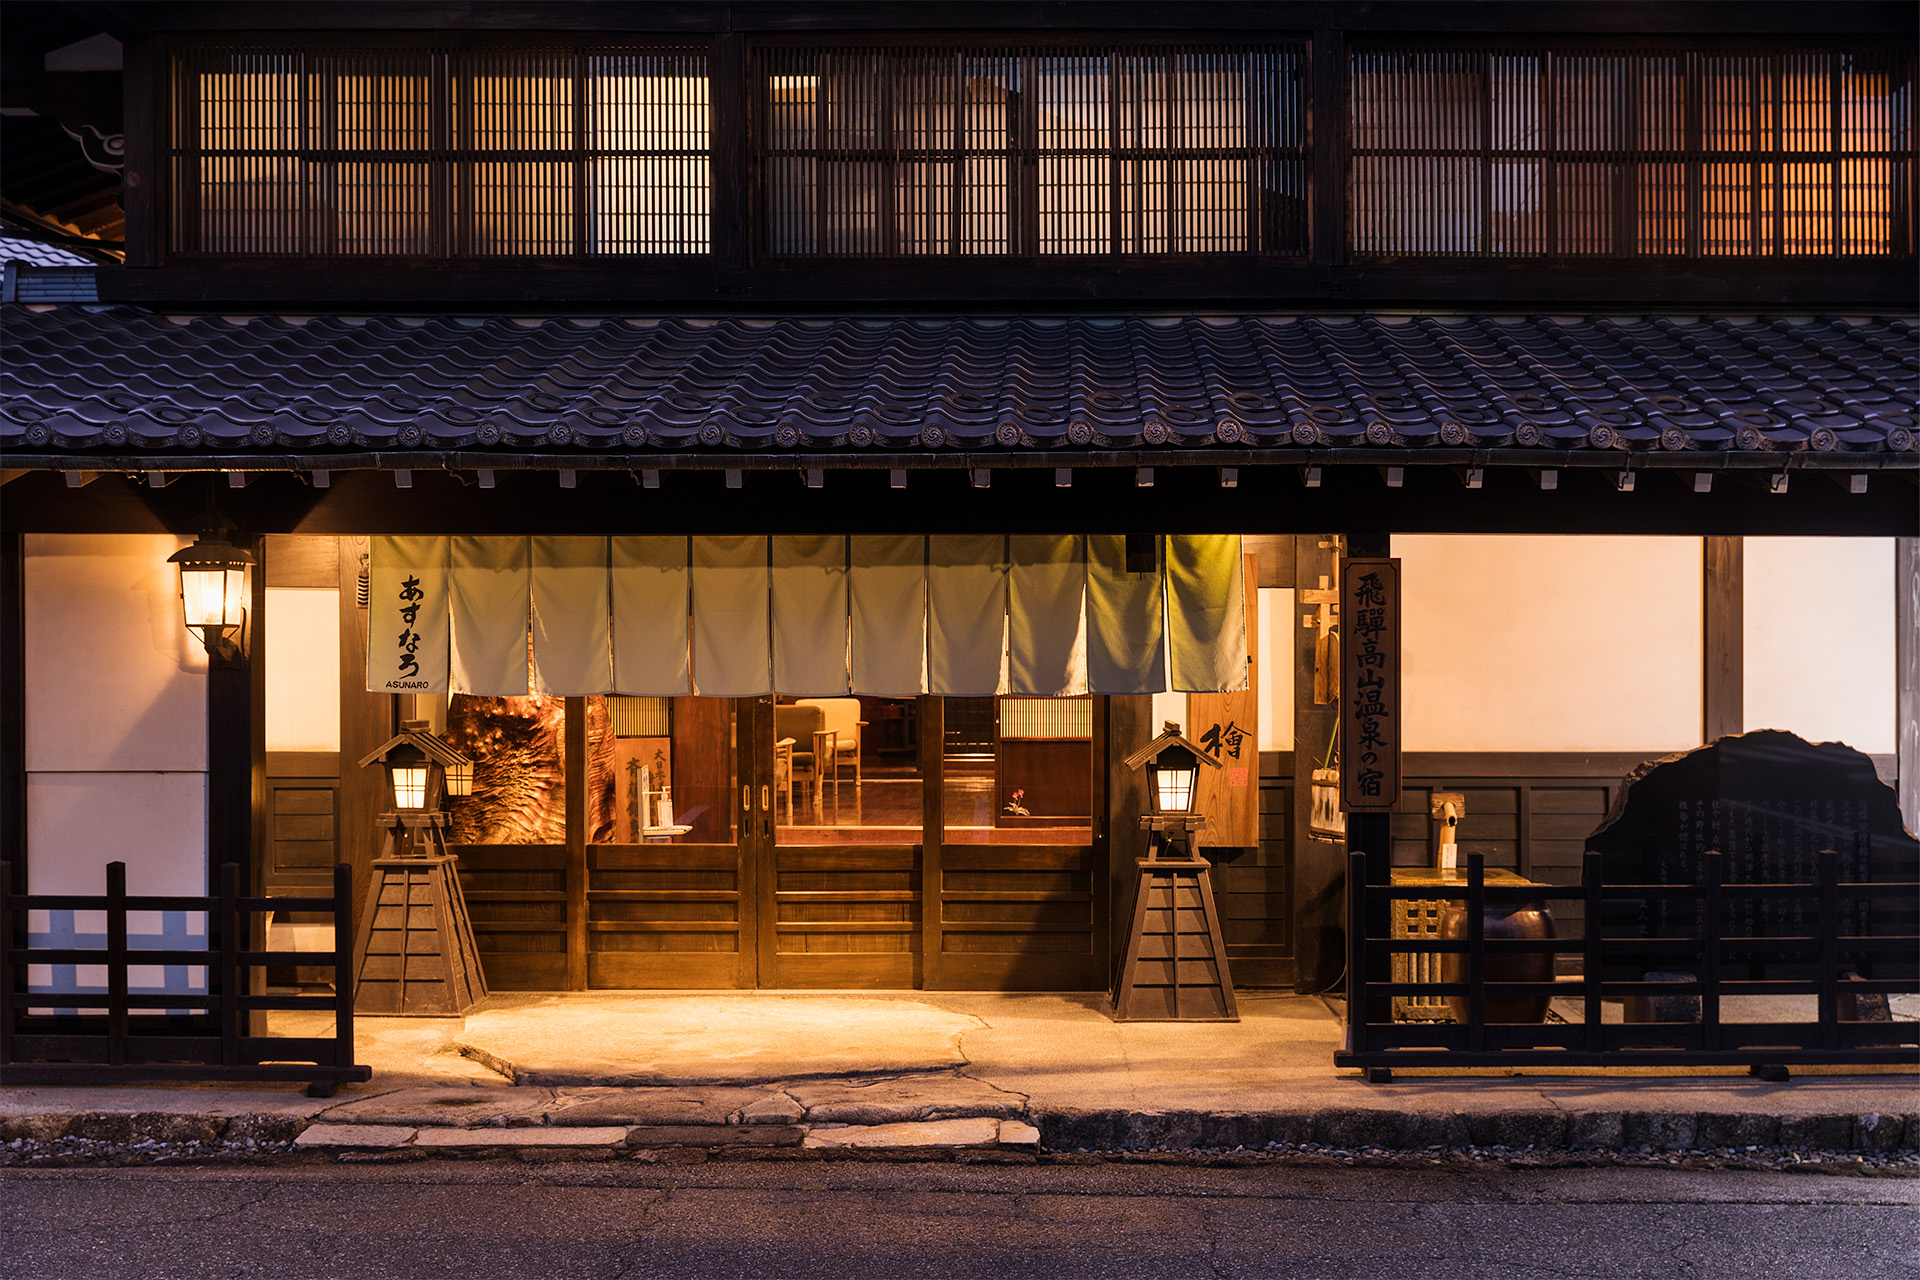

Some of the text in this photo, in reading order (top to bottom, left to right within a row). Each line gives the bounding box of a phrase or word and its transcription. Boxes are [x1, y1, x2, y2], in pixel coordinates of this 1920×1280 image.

[398, 574, 424, 679] あすなろ
[385, 681, 429, 689] ASUNARO
[1200, 720, 1252, 760] 檜
